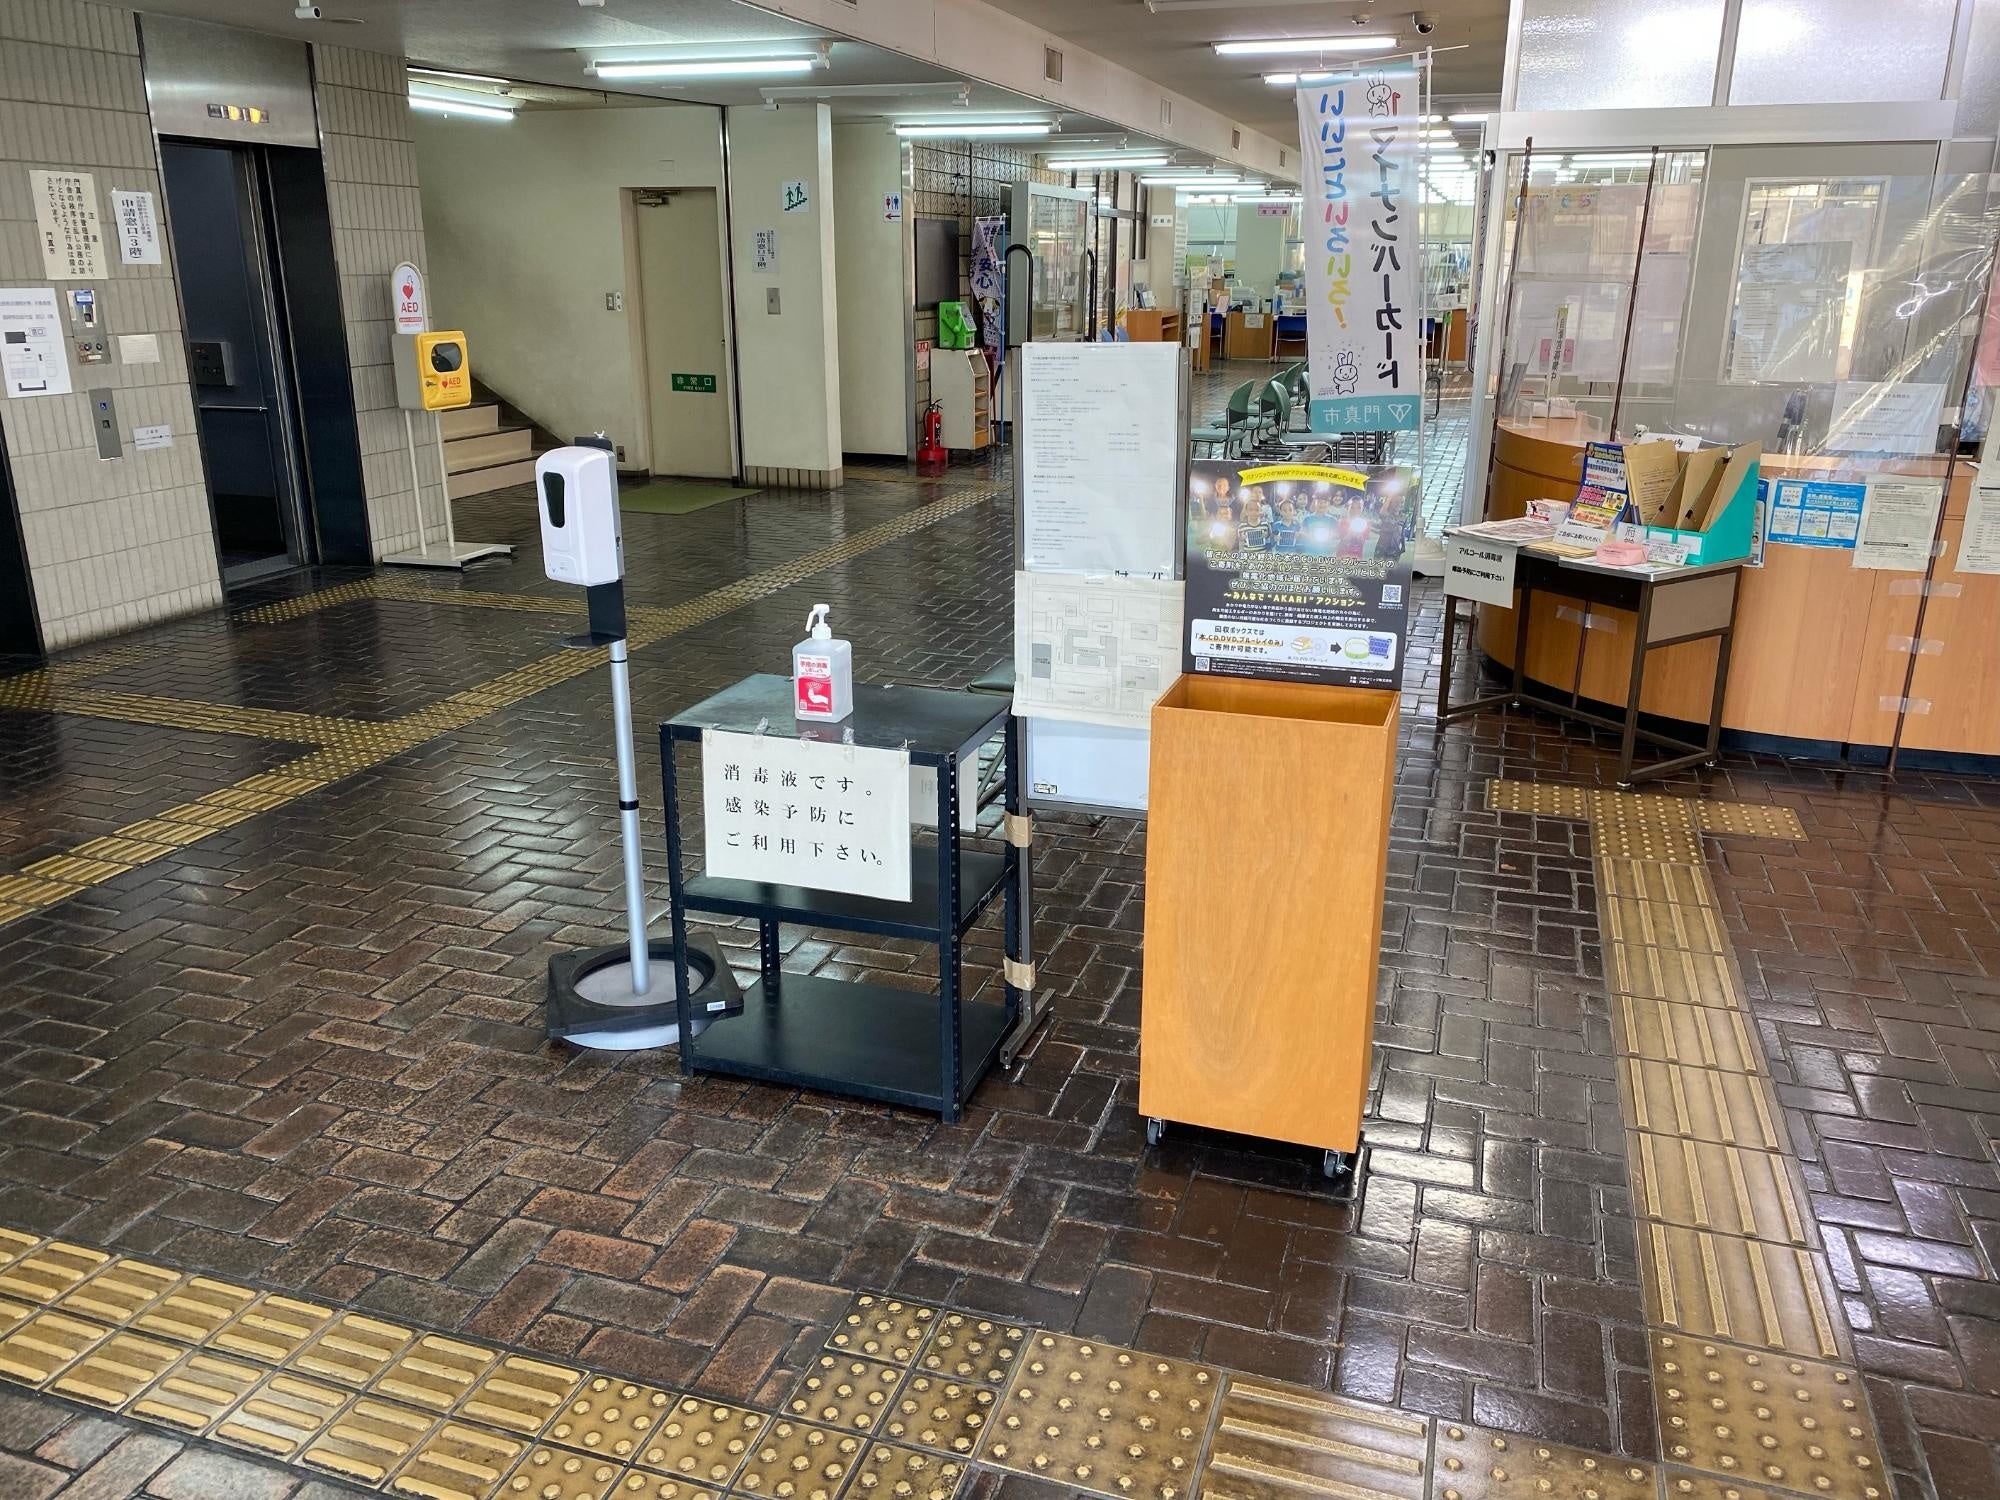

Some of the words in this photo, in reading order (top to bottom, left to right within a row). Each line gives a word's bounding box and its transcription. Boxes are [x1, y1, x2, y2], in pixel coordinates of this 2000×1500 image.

[45, 231, 55, 255] 門真市
[401, 302, 419, 313] AED
[448, 377, 461, 385] AED
[1459, 547, 1503, 562] アルコール消毒液
[1214, 625, 1265, 635] 回収ボックスでは
[723, 763, 872, 797] 消毒液です。
[724, 796, 855, 826] 感染予防に
[725, 831, 884, 867] ご利用下さい。
